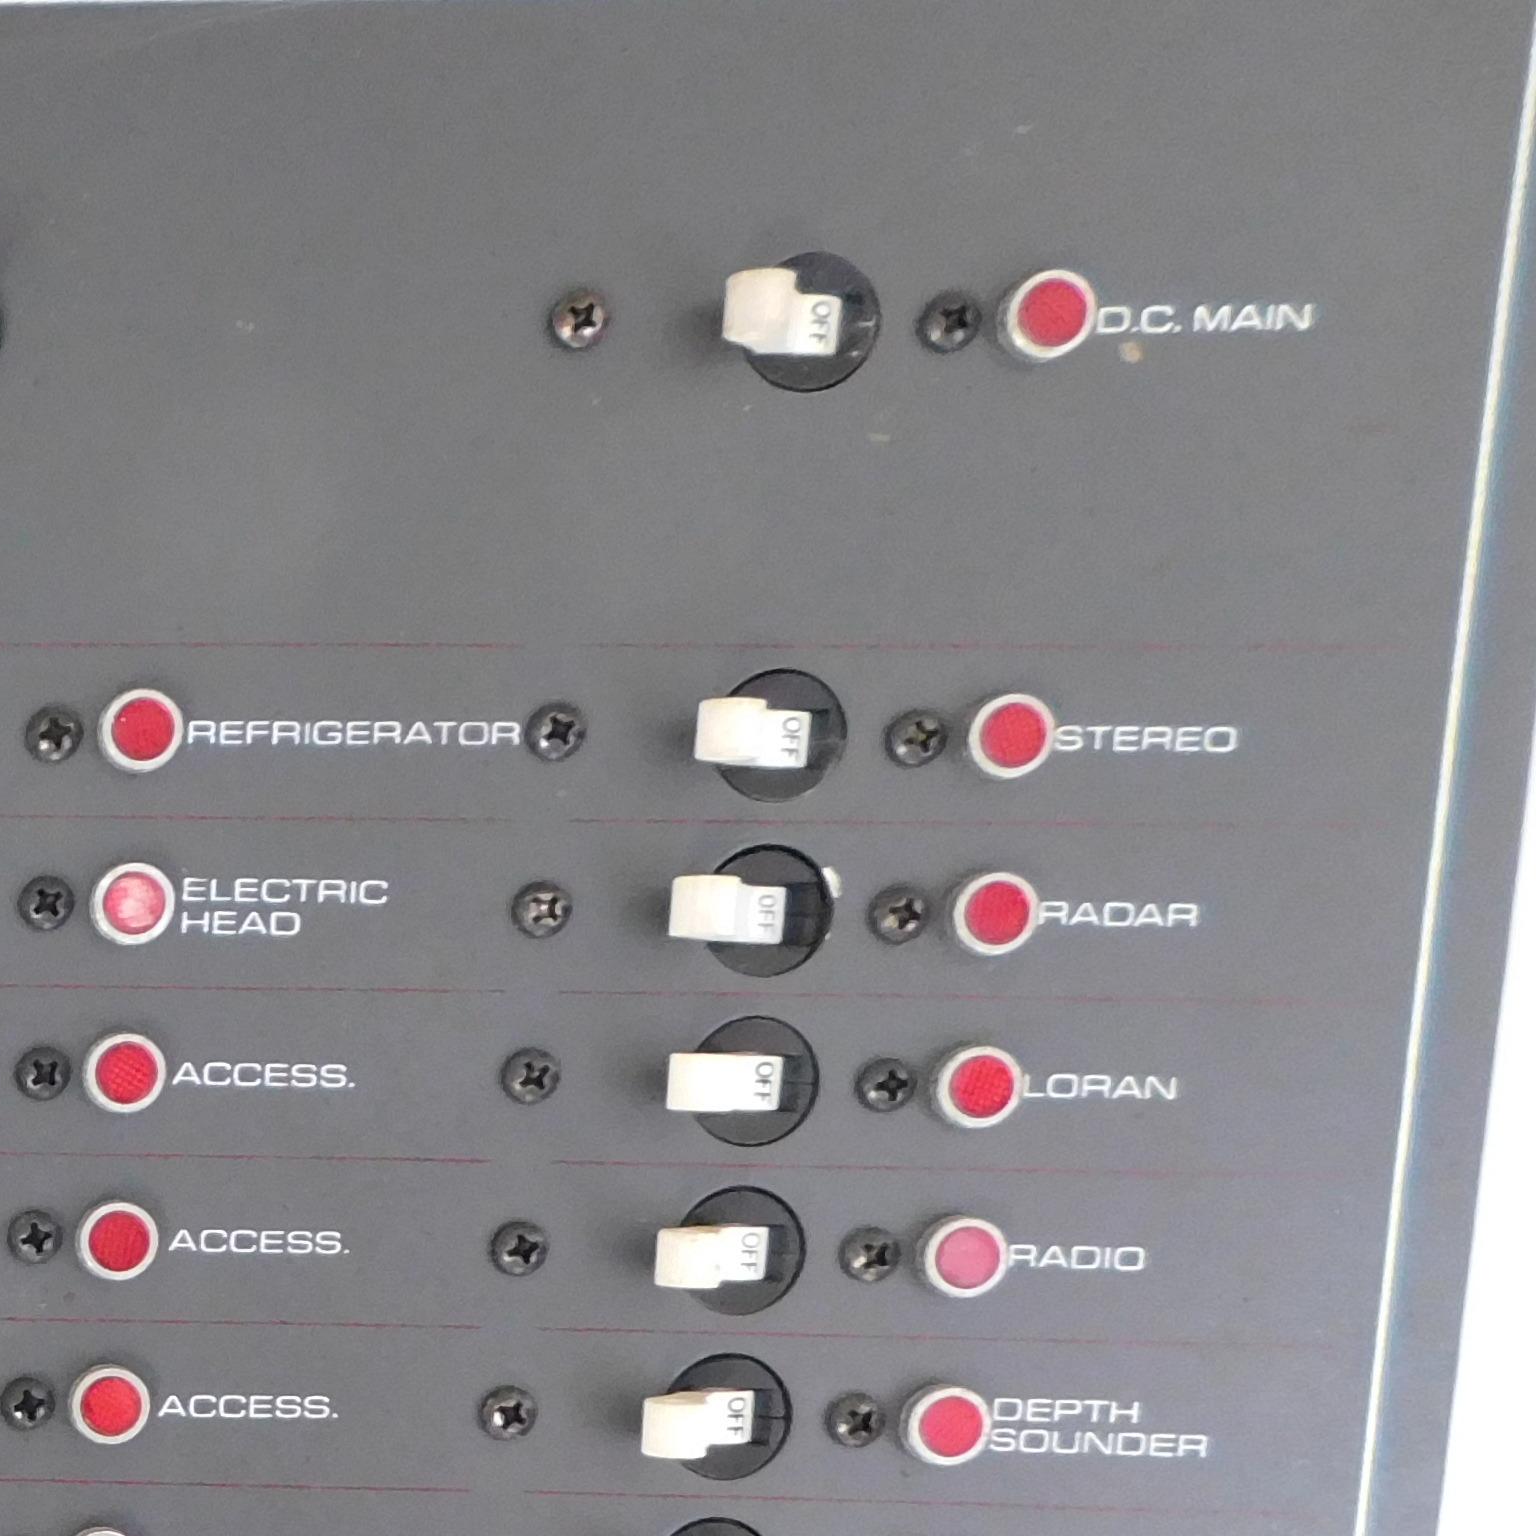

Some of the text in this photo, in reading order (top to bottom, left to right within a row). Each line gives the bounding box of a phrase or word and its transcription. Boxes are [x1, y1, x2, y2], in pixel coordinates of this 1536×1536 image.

[811, 300, 832, 344] OFF
[1095, 304, 1312, 334] D.C. MAIN
[187, 720, 521, 746] REFRIGERATOR
[781, 716, 802, 760] OFF
[1054, 724, 1237, 753] STEREO
[181, 877, 389, 905] ELECTRIC
[180, 910, 301, 936] HEAD
[758, 894, 777, 935] OFF
[1037, 901, 1199, 927] RADAR
[172, 1061, 355, 1089] ACCESS.
[755, 1061, 774, 1104] OFF
[1023, 1073, 1177, 1100] LORAN
[168, 1229, 350, 1255] ACCESS.
[740, 1232, 761, 1273] OFF
[1008, 1241, 1146, 1272] RADIO
[157, 1394, 339, 1419] ACCESS.
[727, 1396, 746, 1440] OFF
[991, 1397, 1140, 1424] DEPTH
[988, 1427, 1209, 1458] SOUNDER
